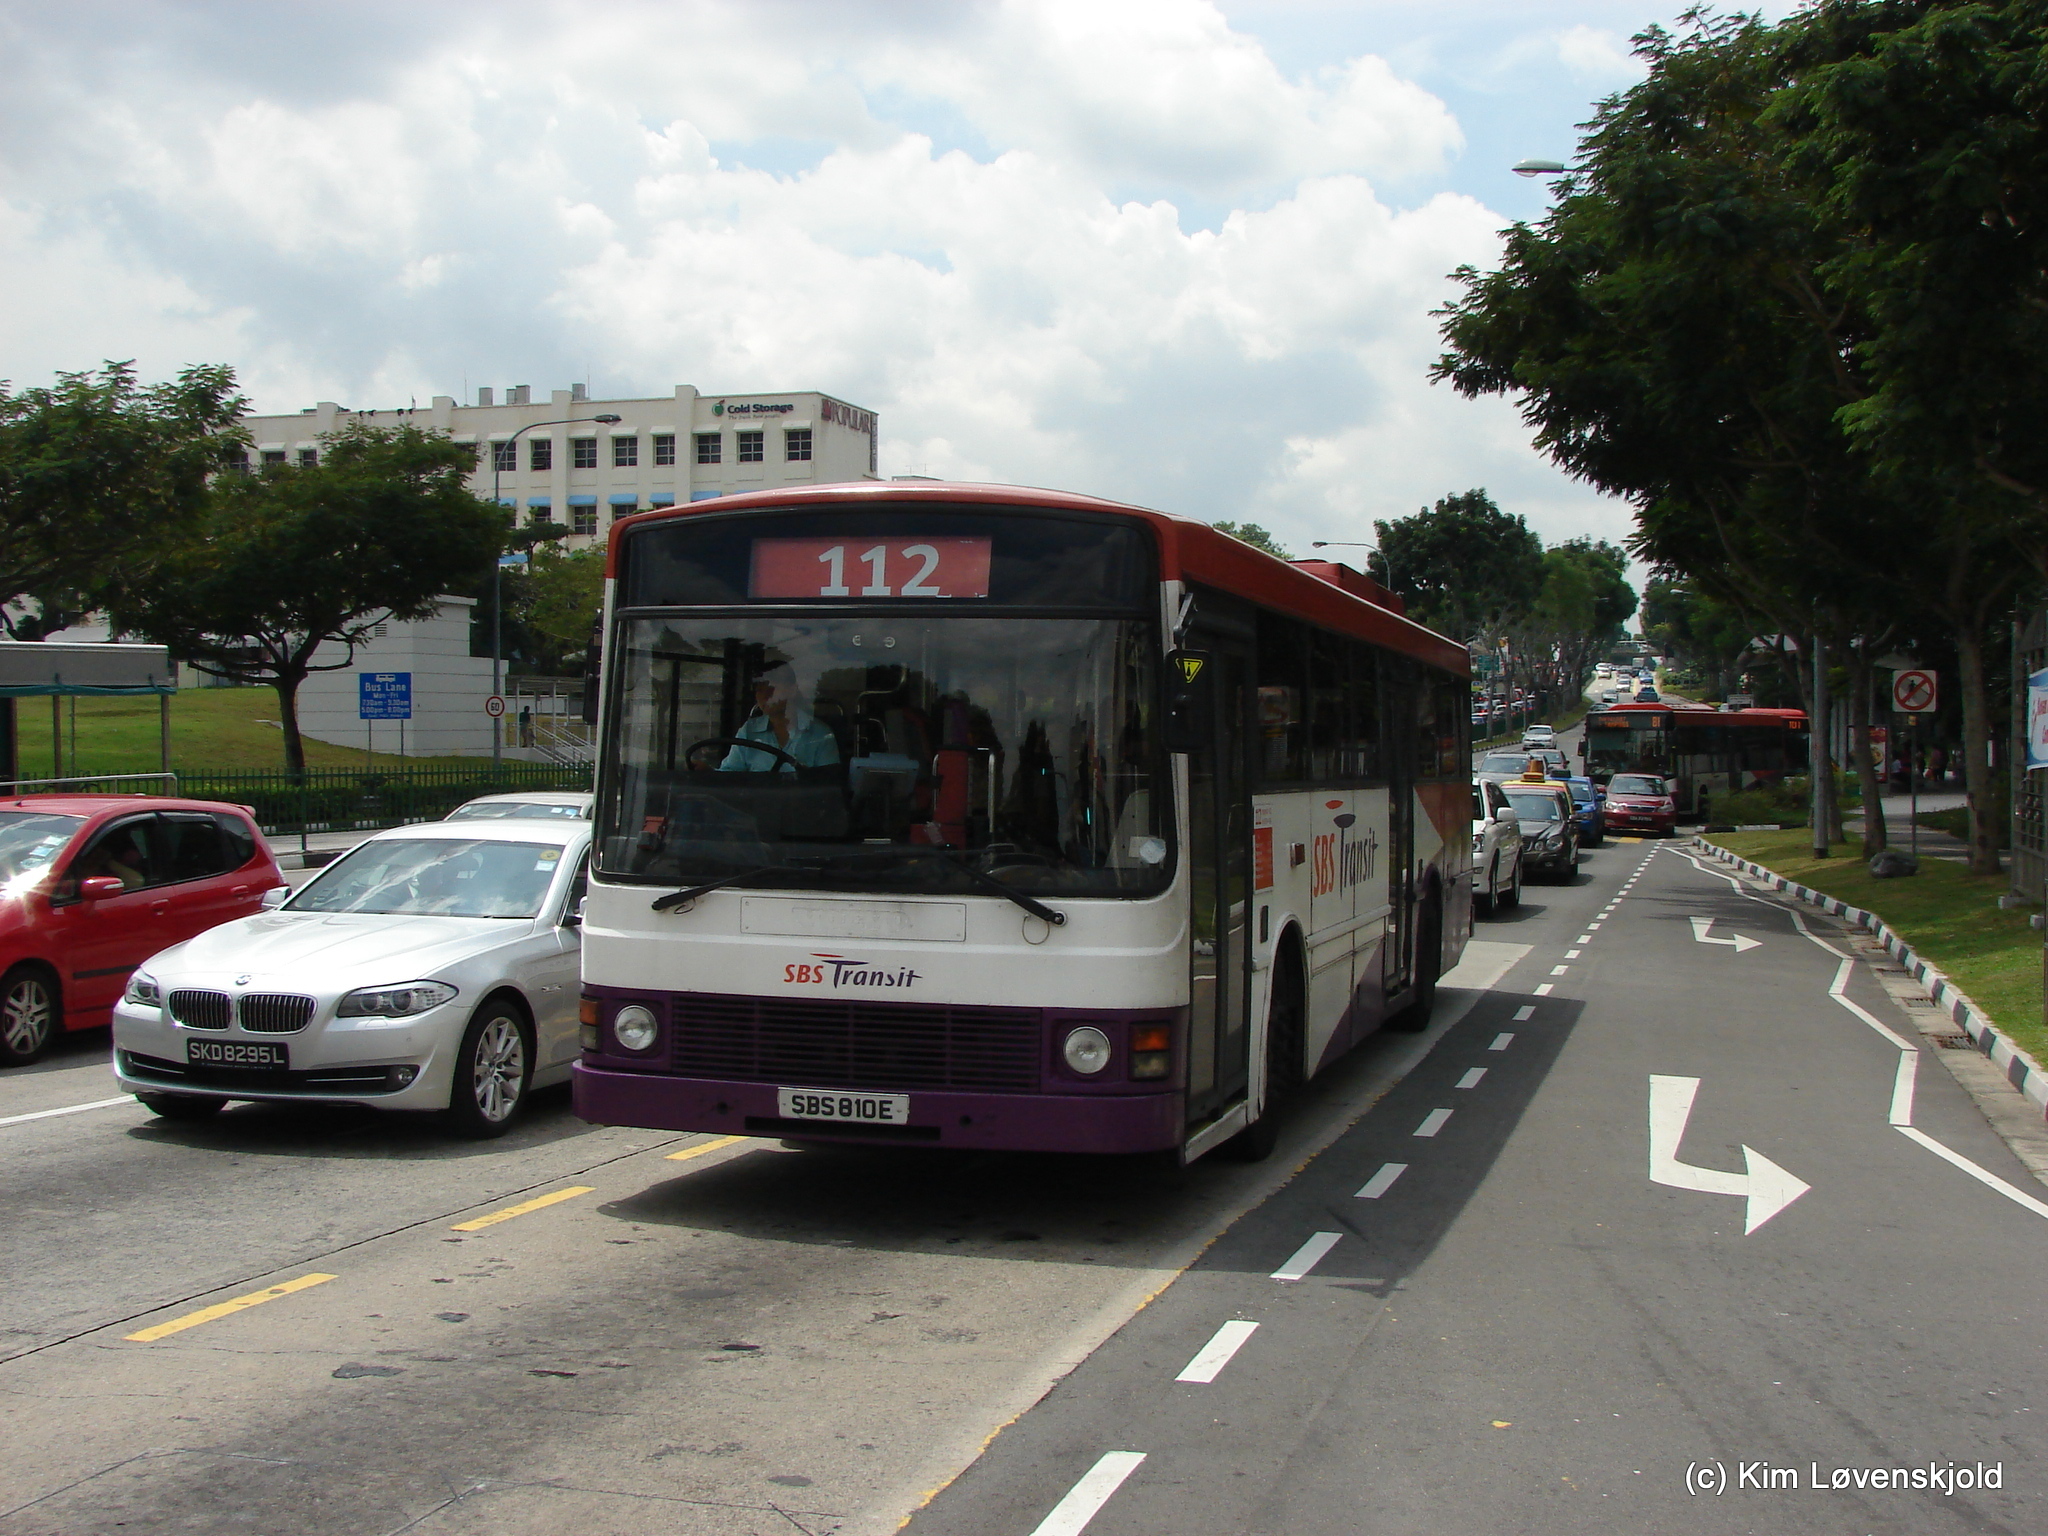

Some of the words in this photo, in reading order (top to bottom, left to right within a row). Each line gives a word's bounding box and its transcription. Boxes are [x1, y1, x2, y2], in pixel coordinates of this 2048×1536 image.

[727, 404, 750, 414] Cold
[752, 403, 794, 413] Storage
[818, 544, 941, 597] 112
[365, 682, 382, 692] Bus
[385, 682, 407, 692] Lane
[490, 702, 500, 712] 60
[1314, 833, 1335, 898] SBS
[1334, 813, 1378, 900] Transit
[783, 964, 824, 984] SBS
[821, 960, 923, 989] Transit
[189, 1042, 285, 1064] SKD8295L
